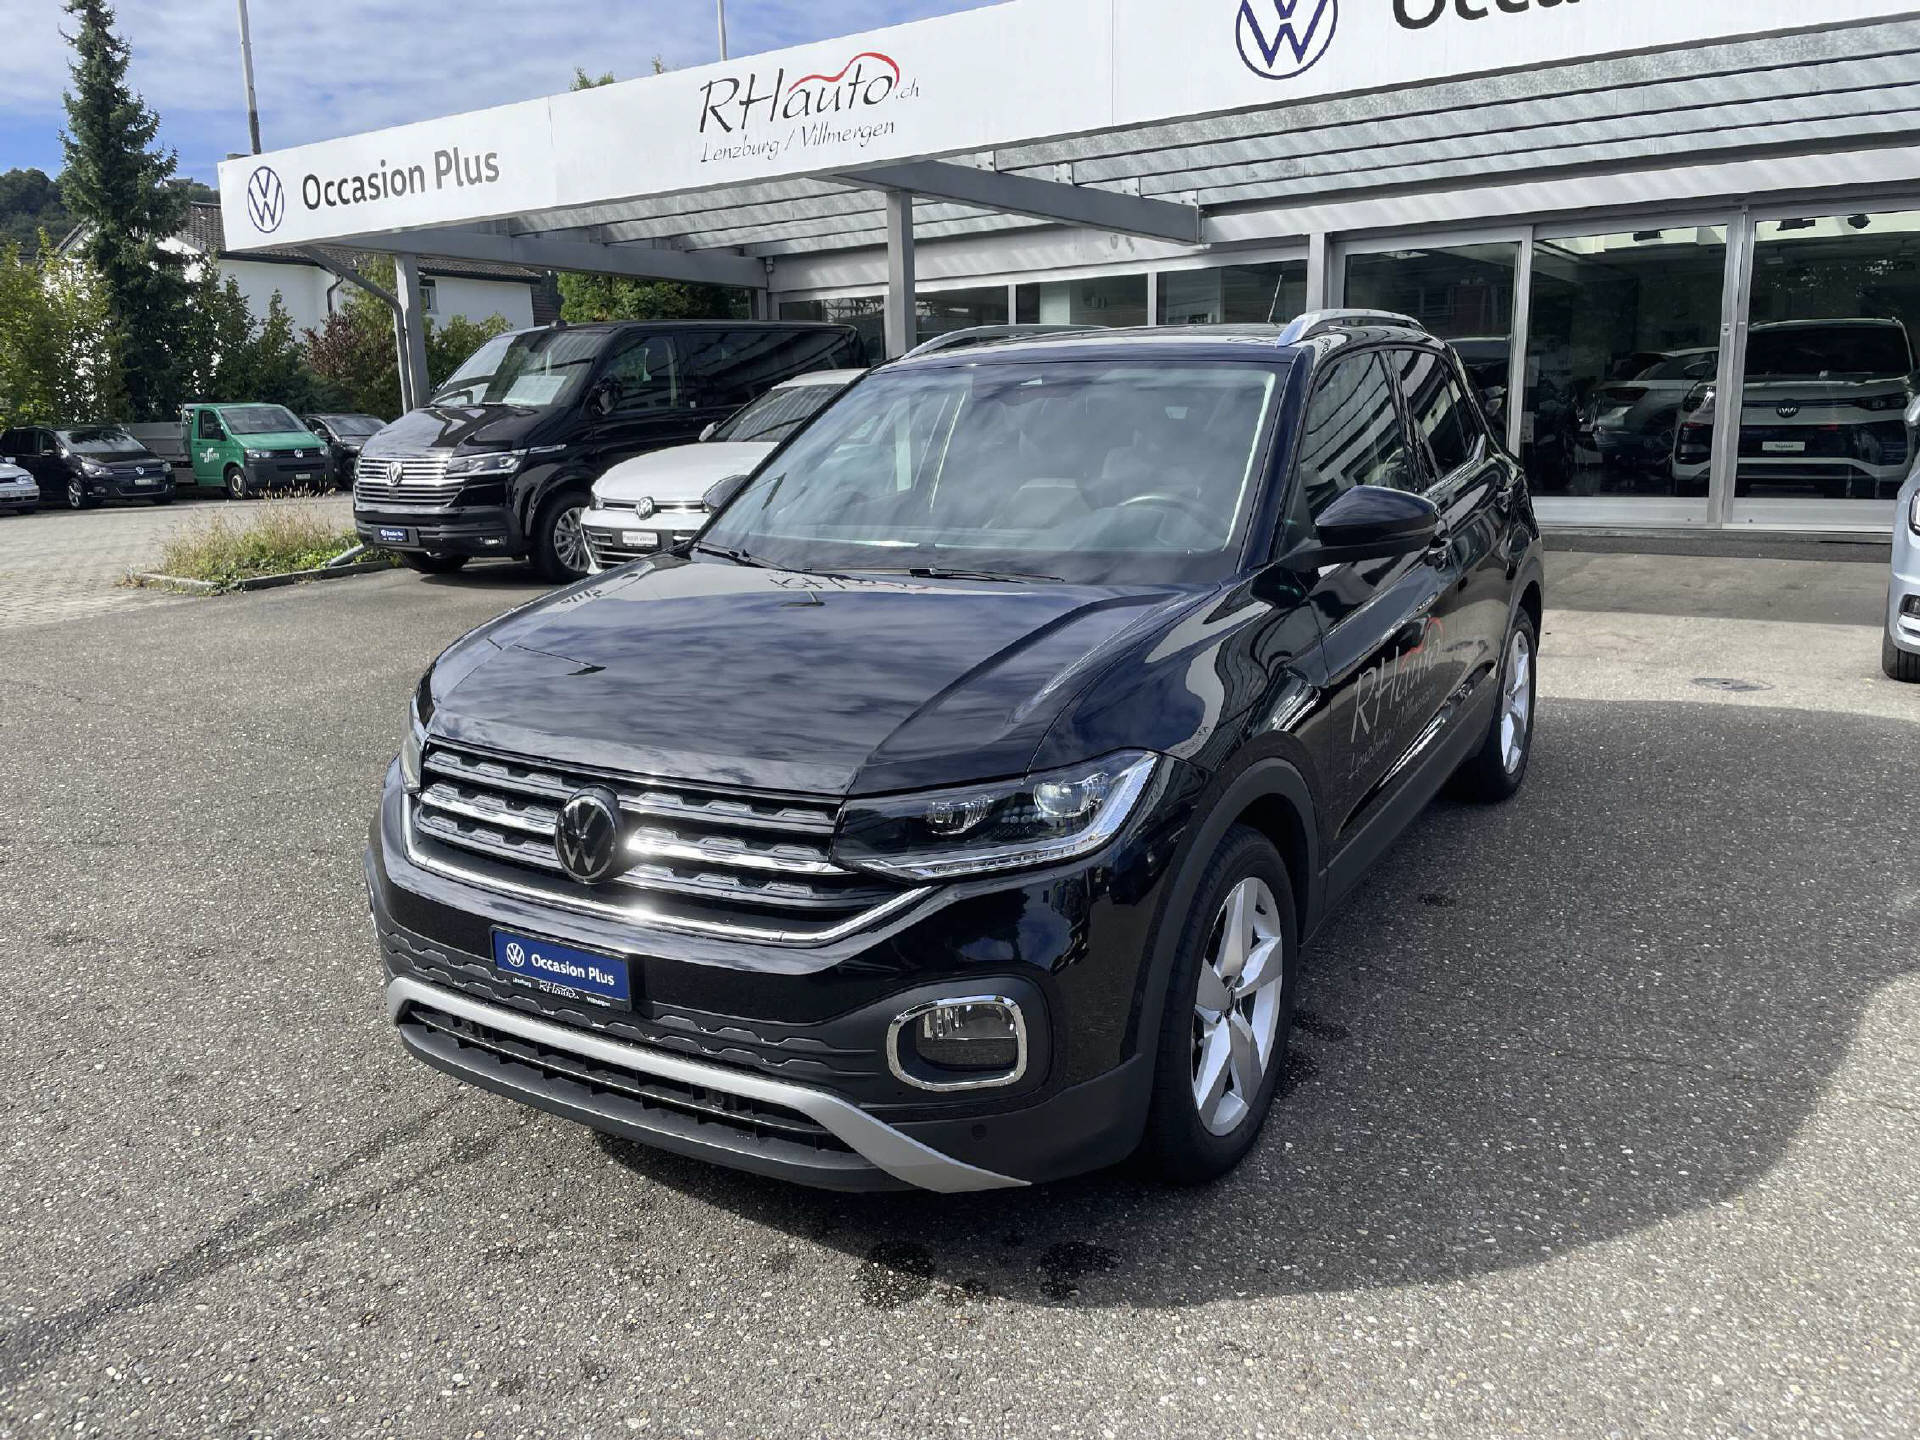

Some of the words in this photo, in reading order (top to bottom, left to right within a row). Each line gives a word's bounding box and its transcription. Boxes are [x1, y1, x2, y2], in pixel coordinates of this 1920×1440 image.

[700, 134, 780, 163] Lenzburg
[800, 119, 895, 148] Villmergen
[302, 159, 426, 211] Occasion
[433, 146, 501, 190] Plus
[531, 953, 585, 979] Occasion
[588, 966, 615, 986] Plus
